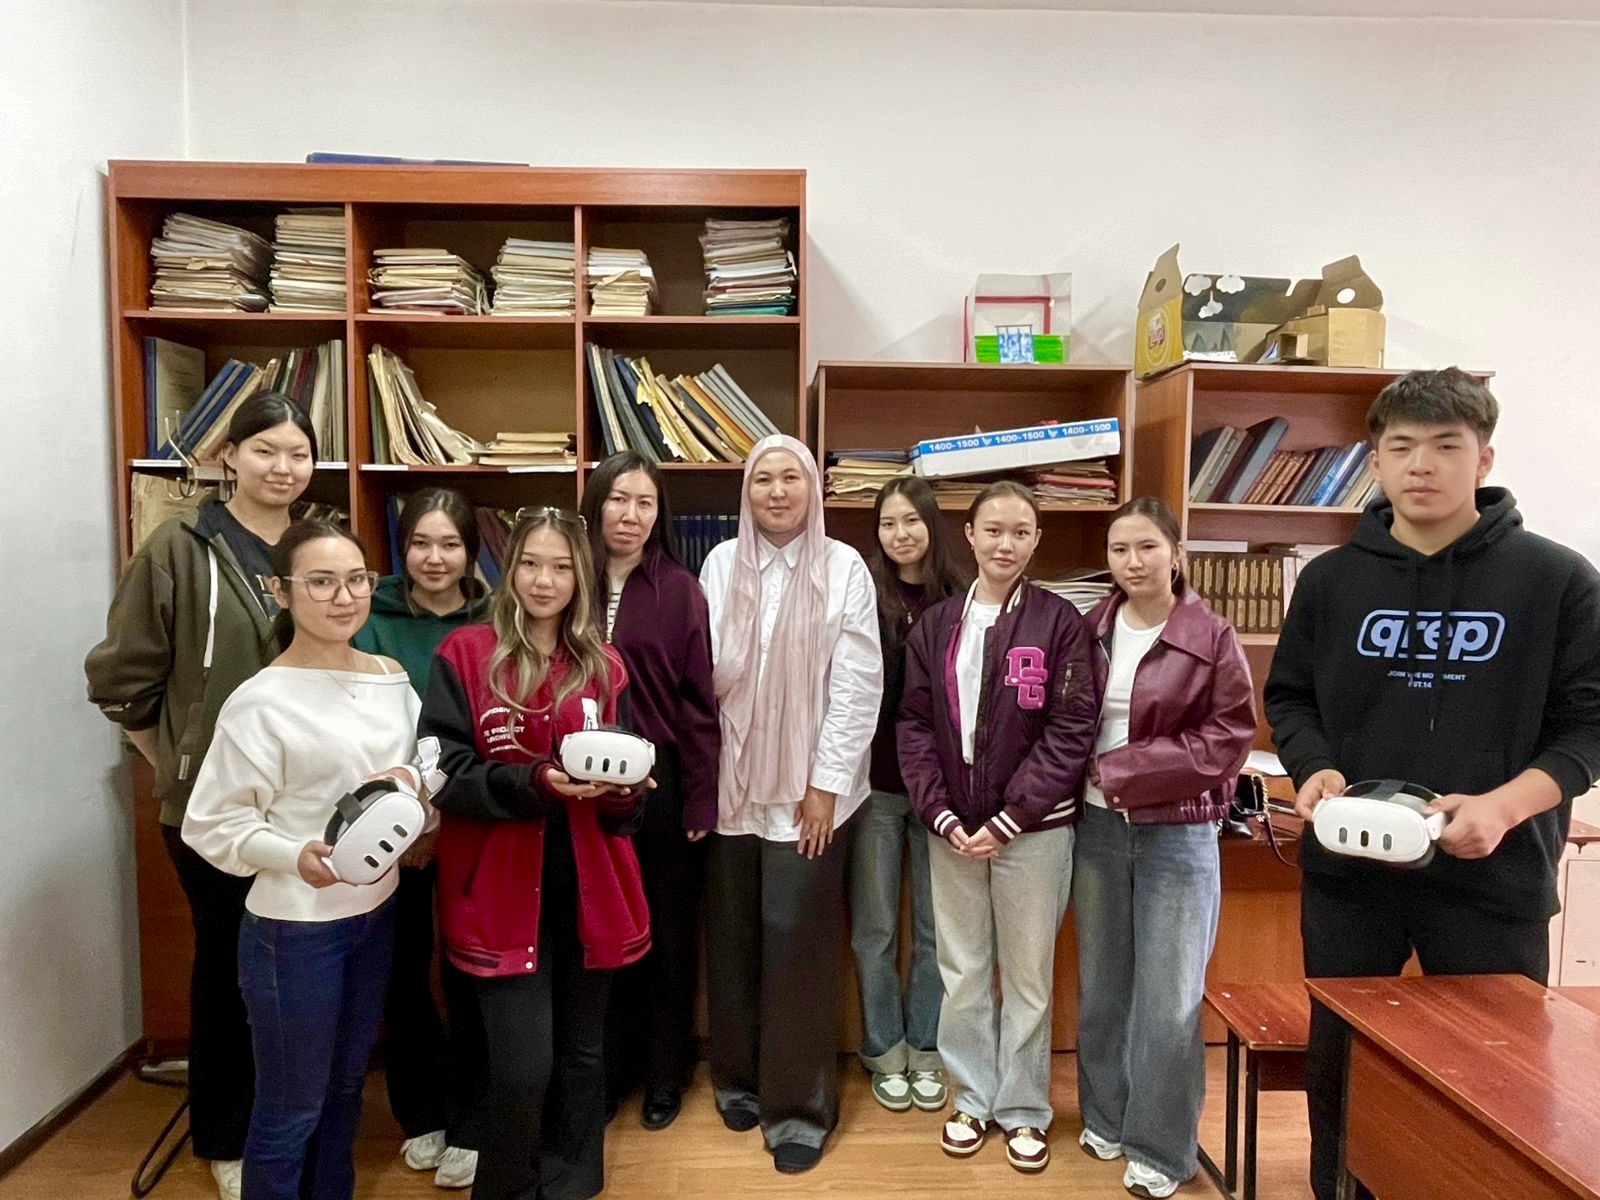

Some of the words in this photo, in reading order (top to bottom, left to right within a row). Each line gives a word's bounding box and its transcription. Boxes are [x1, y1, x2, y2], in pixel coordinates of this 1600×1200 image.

[929, 437, 980, 452] 1400-1500
[995, 430, 1045, 444] 1400-1500
[1062, 422, 1112, 436] 1400-1500
[1407, 671, 1421, 679] TE
[491, 726, 525, 735] PROCT
